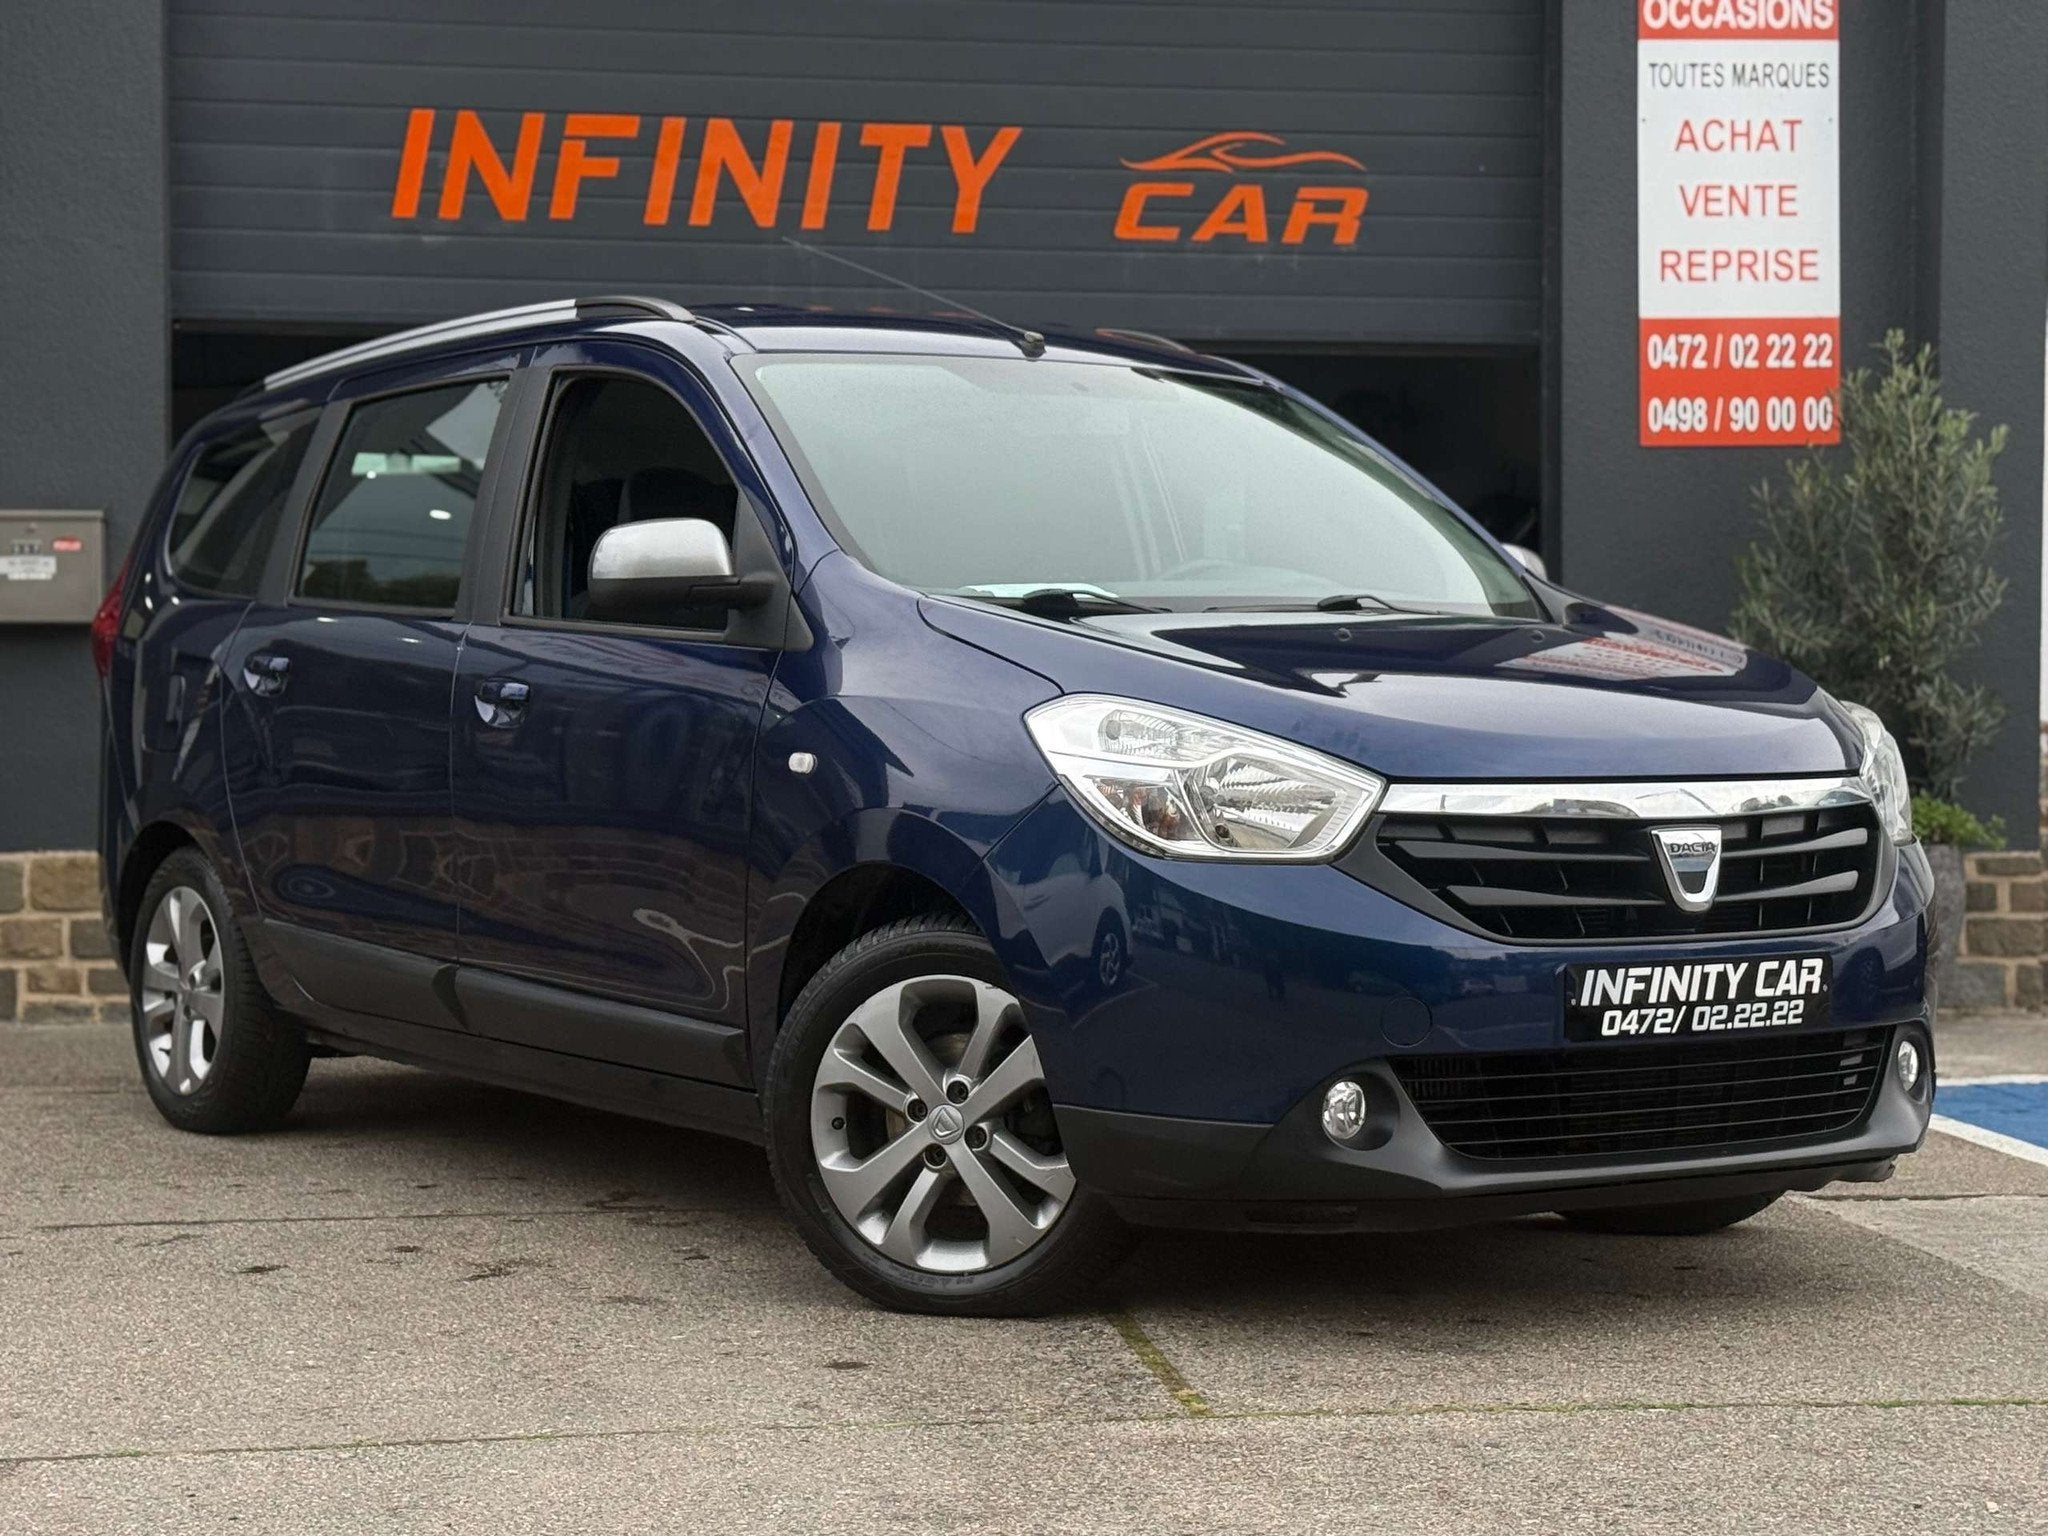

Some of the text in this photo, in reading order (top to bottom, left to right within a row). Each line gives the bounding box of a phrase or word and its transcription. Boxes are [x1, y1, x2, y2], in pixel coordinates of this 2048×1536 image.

[1643, 0, 1835, 29] OCCASIONS
[1649, 62, 1830, 89] TOUTES MARQUES
[1675, 118, 1802, 152] ACHAT
[391, 108, 1368, 245] INFINITY CAR
[1679, 183, 1798, 217] VENTE
[1659, 248, 1819, 282] REPRISE
[1647, 333, 1833, 369] 0472 / 02 22 22
[1647, 396, 1833, 433] 0498 / 90 00 00
[1669, 842, 1716, 854] DACIA
[1580, 957, 1824, 1007] INFINITY CAR
[1601, 999, 1805, 1037] 0472/ 02.22.22
